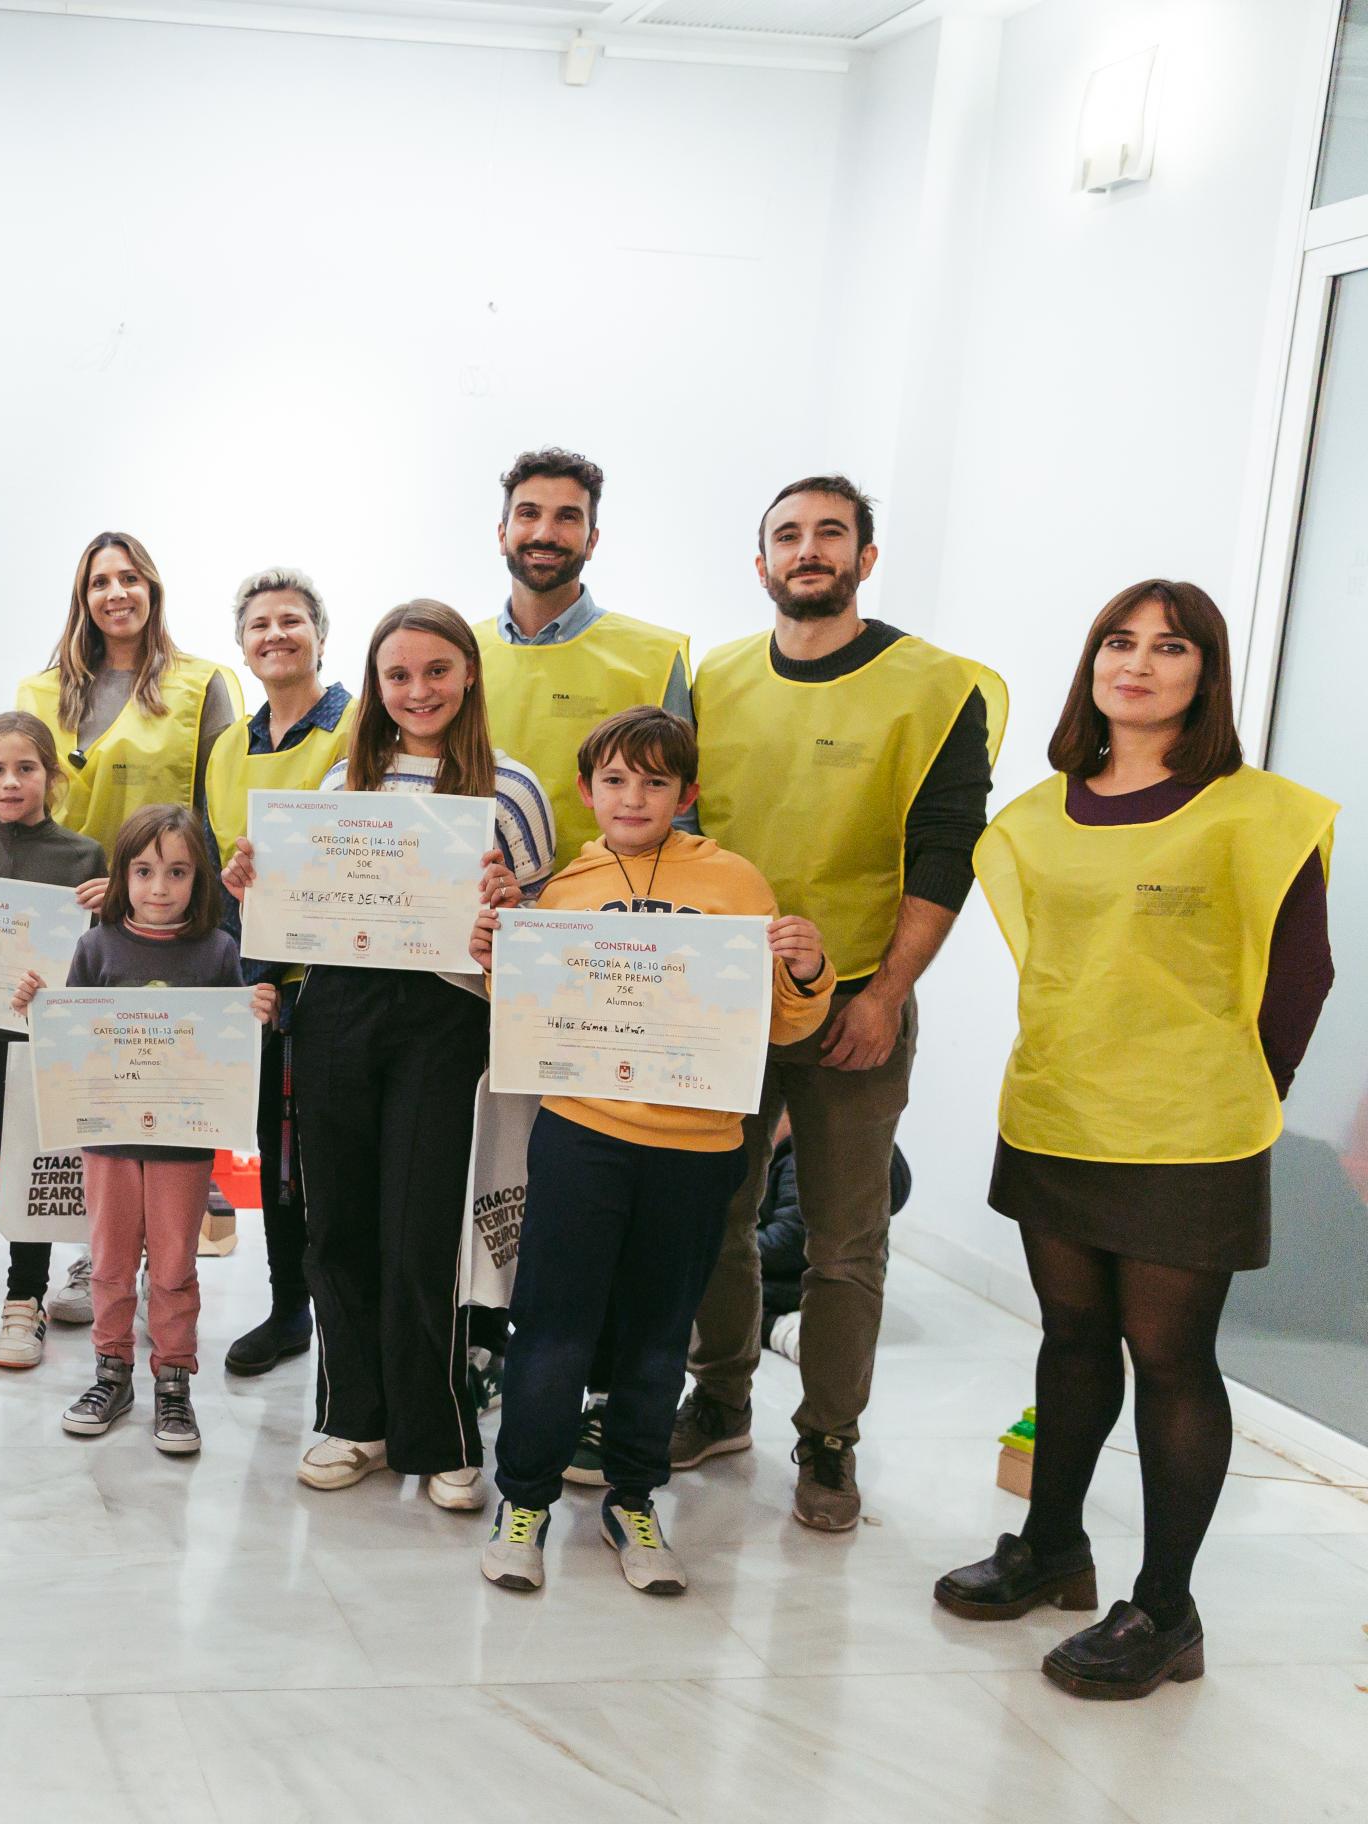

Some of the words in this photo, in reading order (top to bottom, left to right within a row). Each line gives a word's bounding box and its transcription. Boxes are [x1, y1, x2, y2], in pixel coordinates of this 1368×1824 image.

[338, 820, 393, 828] CONSTRULAB
[312, 834, 360, 845] CATEGORÍA
[370, 837, 396, 847] (14-16
[398, 838, 419, 848] años)
[326, 848, 369, 856] SEGUNDO
[290, 891, 314, 902] ALMA
[546, 922, 593, 931] ACREDITATIVO
[594, 942, 657, 952] CONSTRULAB
[567, 958, 621, 969] CATEGORÍA
[633, 961, 658, 971] (8-10
[661, 963, 685, 973] años)
[589, 972, 623, 982] PRIMER
[625, 974, 662, 983] PREMIO
[617, 986, 634, 994] 75€
[94, 1026, 139, 1035] CATEGORÍA
[148, 1028, 172, 1036] (11-13
[671, 1074, 703, 1082] ARQUI
[29, 1187, 84, 1202] DEARQ
[473, 1185, 527, 1215] CTAACO
[28, 1202, 86, 1216] DEALIC
